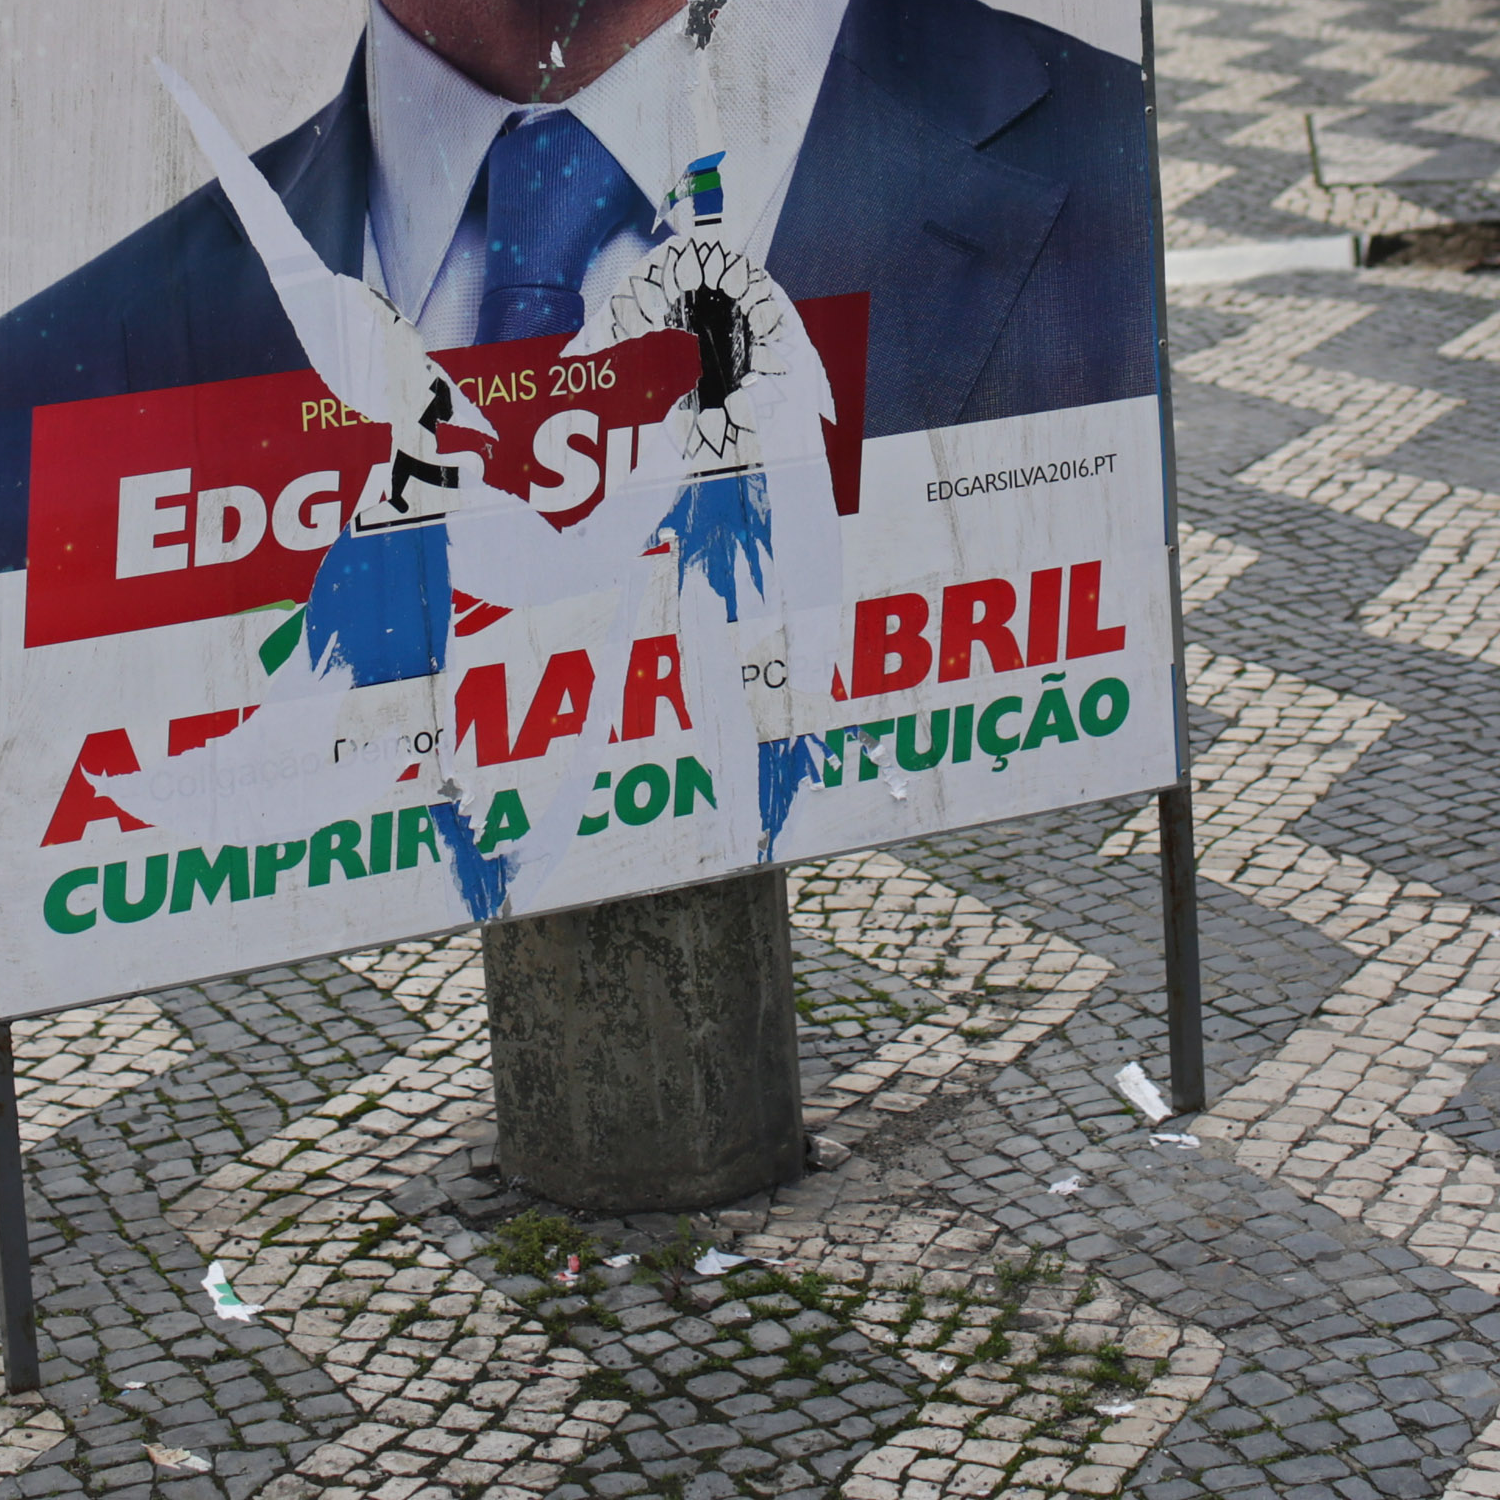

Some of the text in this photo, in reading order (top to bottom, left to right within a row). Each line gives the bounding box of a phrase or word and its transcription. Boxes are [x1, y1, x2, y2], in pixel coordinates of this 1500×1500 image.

[549, 358, 616, 397] 2016
[926, 453, 1118, 503] EDGARSILVA2016.PT
[831, 560, 1126, 702] BRIL
[43, 804, 441, 935] CUMPRIR
